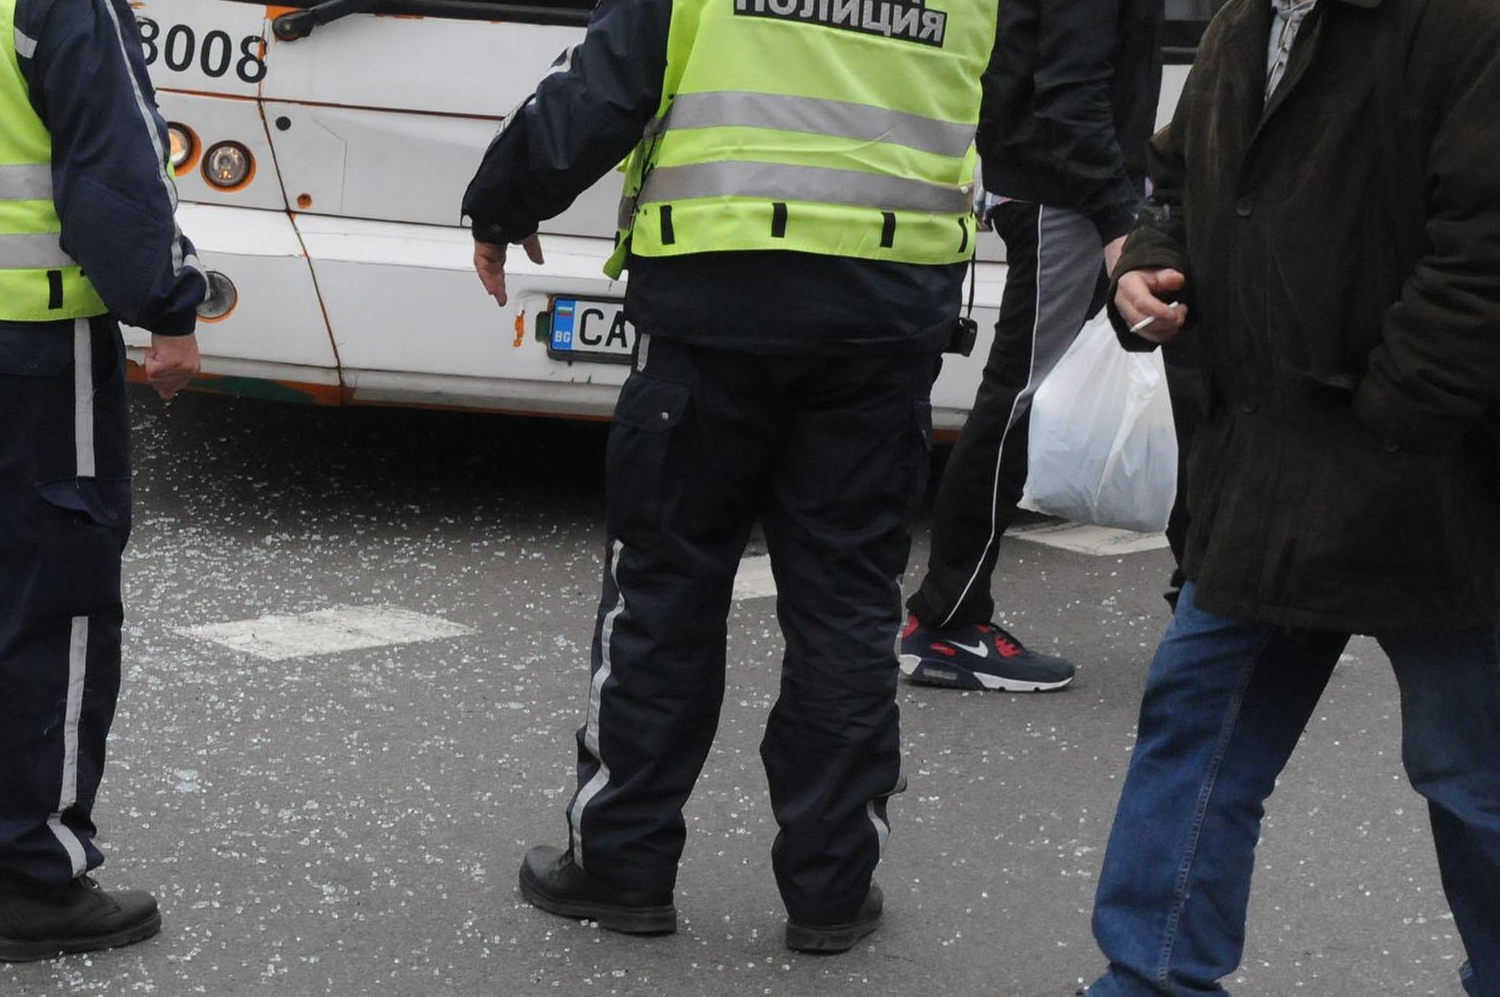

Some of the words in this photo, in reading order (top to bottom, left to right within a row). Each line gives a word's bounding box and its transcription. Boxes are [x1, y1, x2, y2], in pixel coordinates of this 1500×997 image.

[136, 16, 268, 84] 8008
[554, 331, 571, 343] BG
[579, 308, 627, 348] CA
